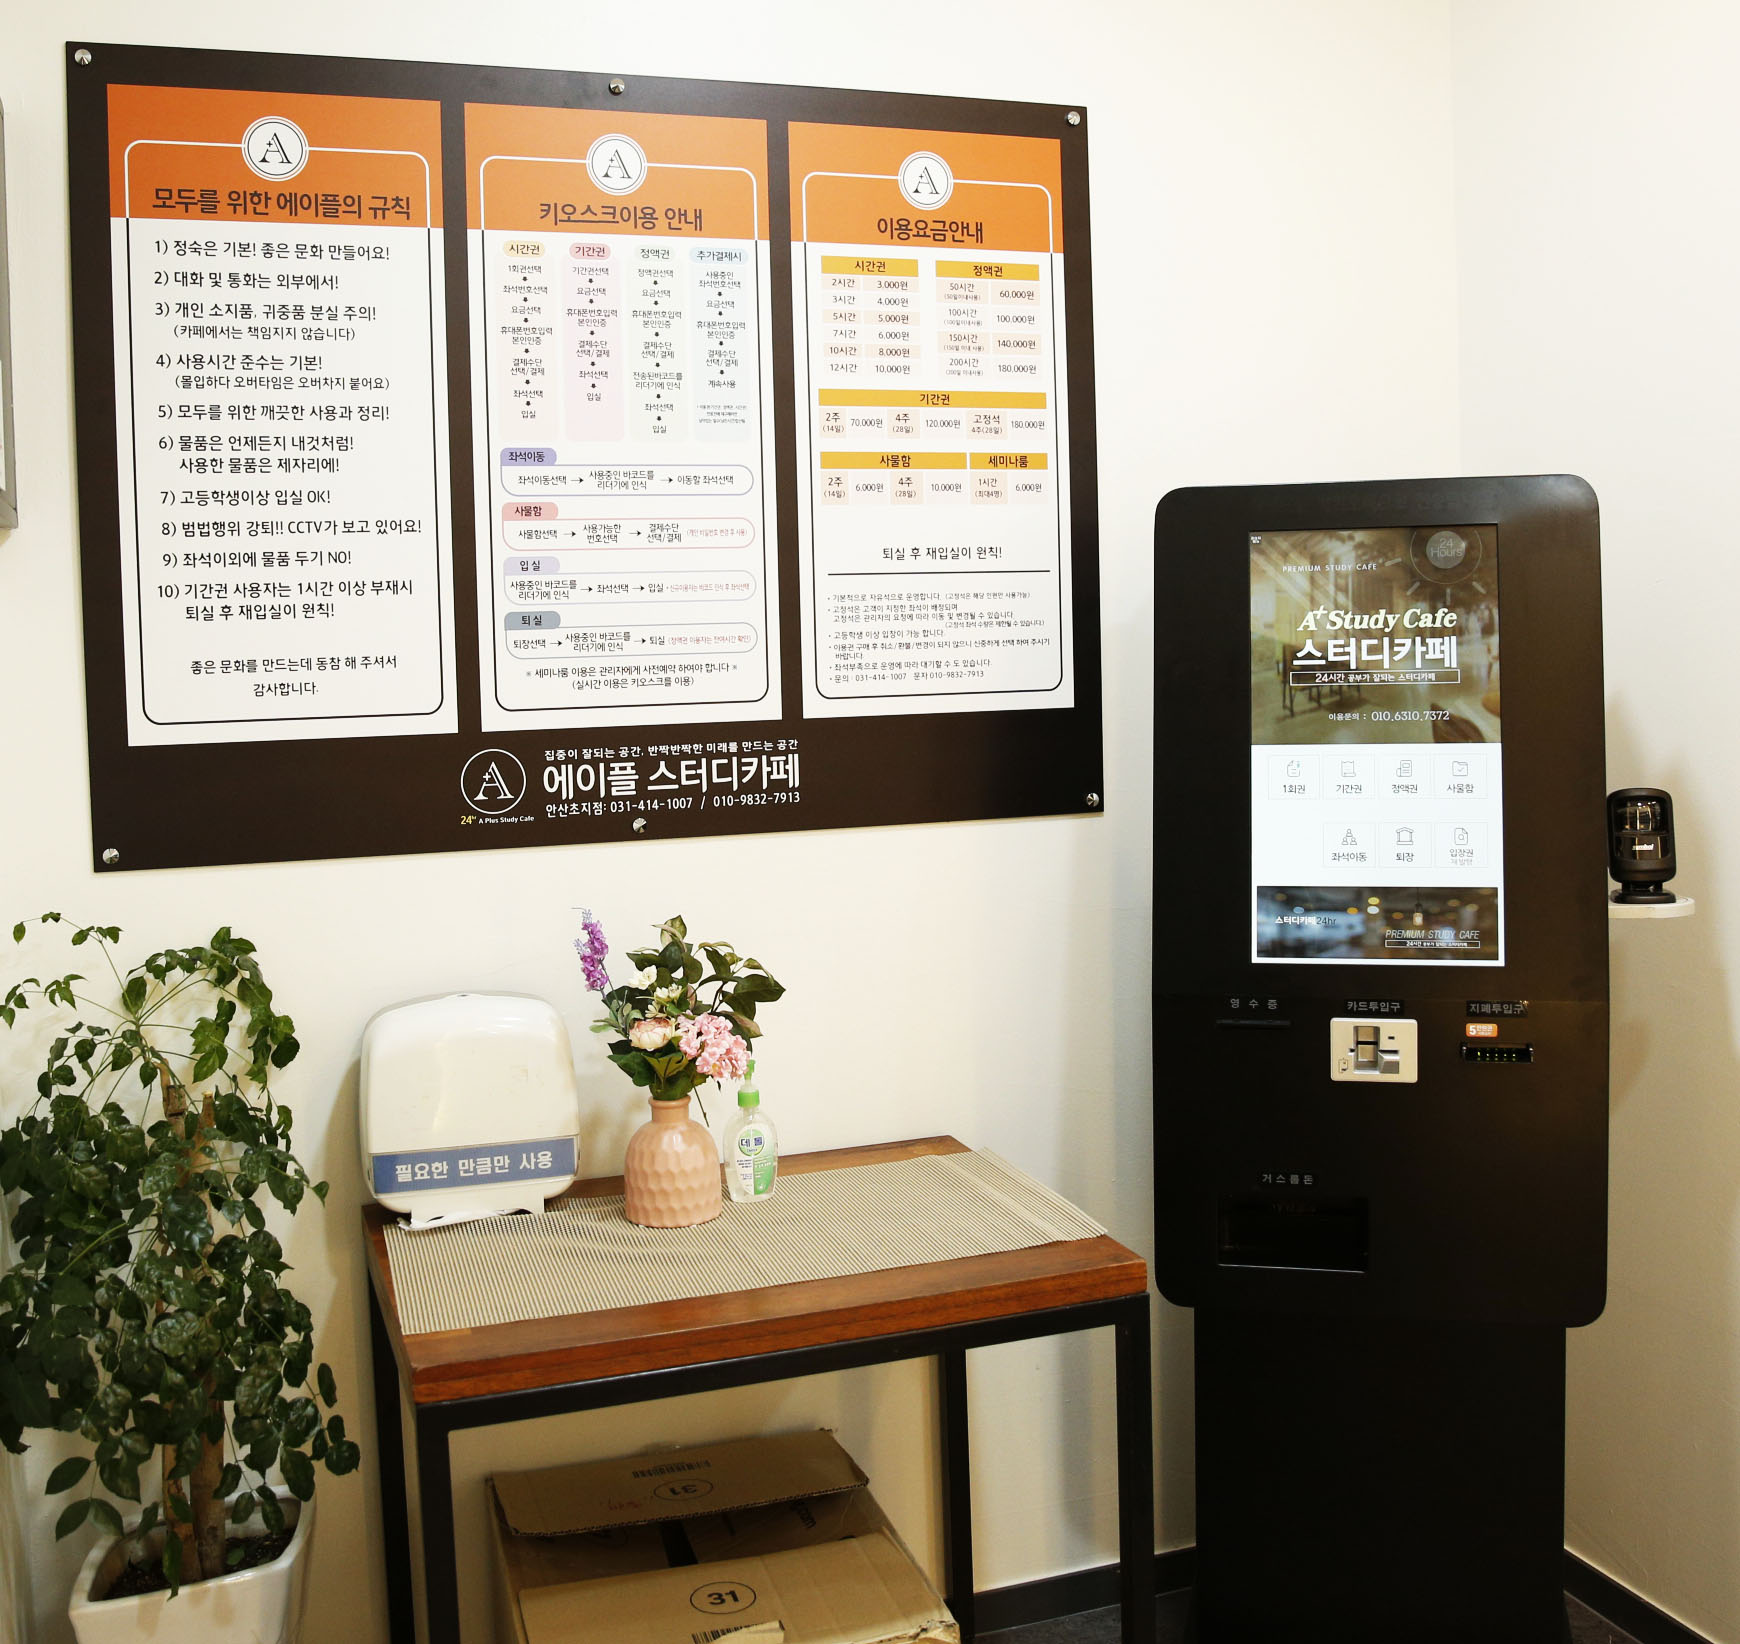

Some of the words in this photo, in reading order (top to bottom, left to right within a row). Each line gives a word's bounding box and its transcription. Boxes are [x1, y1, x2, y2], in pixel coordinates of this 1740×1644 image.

[152, 188, 220, 214] 모두를
[227, 190, 272, 216] 위한
[276, 192, 361, 219] 에이플의
[368, 196, 410, 221] 규칙
[540, 202, 659, 230] 키오스크이용
[664, 208, 702, 232] 안내
[877, 218, 983, 244] 이용요금안내
[155, 240, 168, 255] 1)
[174, 240, 218, 257] 정숙은
[223, 242, 256, 258] 기본!
[261, 243, 290, 259] 좋은
[294, 244, 324, 260] 문화
[328, 245, 389, 261] 만들어요!
[509, 244, 539, 255] 시간권
[575, 246, 605, 257] 기간권
[641, 249, 669, 259] 정액권
[697, 250, 741, 262] 추가결제시
[573, 267, 609, 276] 기간권선택
[855, 260, 886, 273] 시간권
[973, 265, 1003, 277] 정액권
[638, 268, 674, 278] 정액권선택
[154, 271, 169, 286] 2)
[174, 271, 204, 287] 대화
[209, 272, 222, 288] 및
[227, 272, 271, 289] 통화는
[277, 274, 338, 290] 외부에서!
[832, 278, 855, 288] 2시간
[503, 285, 548, 294] 좌석번호선택
[577, 287, 606, 296] 요금선택
[950, 283, 975, 293] 50시간
[833, 296, 855, 305] 3시간
[155, 302, 170, 317] 3)
[175, 302, 203, 318] 개인
[209, 303, 257, 319] 소지품,
[262, 304, 306, 320] 귀중품
[310, 305, 338, 321] 분실
[343, 306, 376, 321] 주의!
[833, 312, 856, 322] 5시간
[949, 308, 977, 318] 100시간
[174, 325, 243, 339] (카페에서는
[247, 326, 296, 340] 책임지지
[301, 327, 355, 341] 않습니다)
[500, 326, 553, 335] 휴대폰번호입력
[833, 329, 856, 339] 7시간
[949, 334, 978, 344] 150시간
[830, 346, 857, 356] 10시간
[830, 363, 857, 373] 12시간
[949, 358, 979, 368] 200시간
[708, 380, 736, 388] 계속사용
[920, 394, 950, 406] 기간권
[158, 404, 173, 419] 5)
[177, 405, 222, 421] 모두를
[228, 405, 257, 420] 위한
[261, 405, 305, 421] 깨끗한
[310, 405, 353, 421] 사용과
[357, 406, 389, 421] 정리!
[826, 412, 840, 423] 2주
[895, 413, 910, 423] 4주
[974, 415, 1000, 425] 고정석
[508, 451, 545, 463] 좌석이동
[880, 455, 911, 468] 사물함
[988, 455, 1028, 468] 세미나룸
[518, 475, 567, 485] 좌석이동선택
[597, 480, 629, 490] 리더기에
[631, 480, 647, 490] 인식
[677, 475, 701, 485] 이동할
[703, 475, 733, 485] 좌석선택
[979, 478, 997, 487] 1시간
[160, 490, 175, 506] 7)
[180, 490, 270, 506] 고등학생이상
[275, 490, 302, 506] 입실
[307, 490, 330, 503] OK!
[515, 506, 542, 517] 사물함
[162, 522, 176, 537] 8)
[182, 521, 240, 537] 범법행위
[246, 521, 283, 537] 강퇴!!
[288, 520, 338, 535] CCTV가
[342, 520, 370, 533] 보고
[375, 519, 421, 535] 있어요!
[518, 529, 557, 539] 사물함선택
[1439, 537, 1454, 548] 24
[883, 547, 905, 561] 퇴실
[910, 547, 921, 560] 후
[926, 547, 971, 560] 재입실이
[977, 546, 1002, 559] 원칙!
[1429, 547, 1463, 558] Hours
[1282, 564, 1321, 573] PREMIUM
[1325, 564, 1354, 572] STUDY
[1356, 563, 1378, 571] CAFE
[1296, 605, 1328, 632] A+
[1326, 609, 1400, 632] Study
[1403, 607, 1458, 629] Cafe
[1292, 635, 1458, 670] 스터디카페
[535, 668, 568, 678] 세미나룸
[571, 667, 596, 678] 이용은
[599, 665, 641, 676] 관리자에게
[643, 664, 676, 675] 사전예약
[678, 664, 703, 673] 하여야
[705, 663, 729, 673] 합니다
[572, 679, 601, 690] (실시간
[603, 678, 629, 689] 이용은
[631, 677, 672, 688] 키오스크를
[674, 676, 694, 687] 이용)
[1315, 673, 1345, 683] 24시간
[1347, 673, 1371, 682] 공부가
[1372, 673, 1395, 682] 잘되는
[1397, 672, 1436, 682] 스터디카페
[253, 682, 318, 697] 감사합니다.
[1328, 713, 1360, 721] 이용문의
[1371, 710, 1450, 722] 010.6310.7372
[545, 749, 577, 761] 집중이
[582, 748, 615, 759] 잘되는
[618, 746, 644, 758] 공간,
[648, 743, 703, 756] 반짝반짝한
[706, 742, 738, 753] 미래를
[742, 740, 774, 752] 만드는
[777, 739, 798, 750] 공간
[543, 758, 639, 800] 에이플
[647, 751, 799, 795] 스터디카페
[1283, 784, 1305, 794] 1회권
[1336, 784, 1362, 794] 기간권
[1392, 784, 1418, 794] 정액권
[1447, 783, 1474, 793] 사물함
[546, 801, 606, 818] 안산초지점:
[610, 797, 692, 813] 031-414-1007
[700, 795, 706, 810] /
[713, 791, 800, 807] 010-9832-7913
[460, 815, 477, 825] 24hr
[1332, 852, 1367, 862] 좌석이동
[1396, 852, 1414, 862] 퇴장
[1385, 929, 1425, 939] PREMIUM
[1427, 930, 1456, 939] STUDY
[1459, 930, 1480, 939] CAFE
[1346, 1001, 1401, 1013] 카드투입구
[1470, 1003, 1524, 1014] 지폐투입구
[395, 1162, 449, 1182] 필요한
[458, 1156, 512, 1178] 만큼만
[518, 1150, 553, 1171] 사용
[706, 1589, 740, 1606] 31
